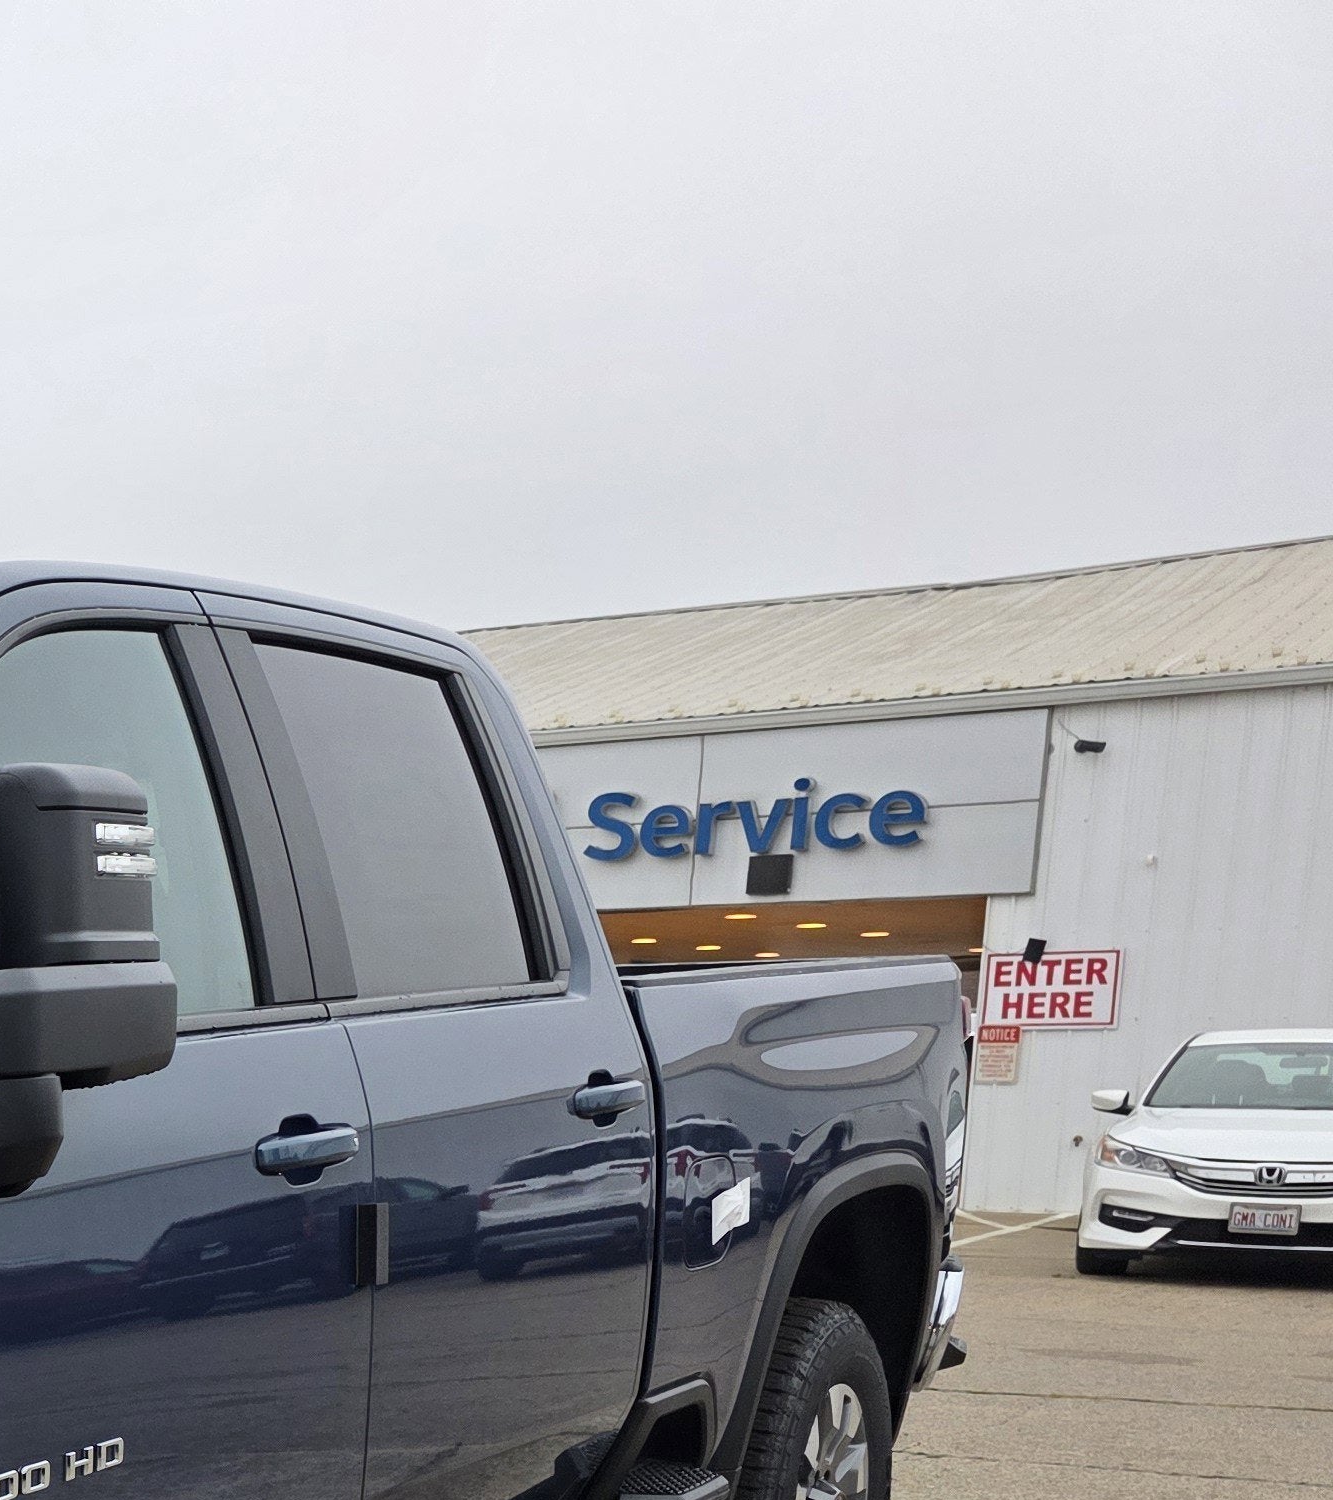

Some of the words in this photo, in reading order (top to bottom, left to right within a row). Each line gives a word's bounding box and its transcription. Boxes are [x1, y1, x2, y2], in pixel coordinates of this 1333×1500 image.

[583, 777, 930, 862] Service
[993, 957, 1109, 988] ENTER
[1001, 991, 1094, 1019] HERE
[981, 1028, 1017, 1041] NOTICE
[64, 1437, 125, 1481] HD
